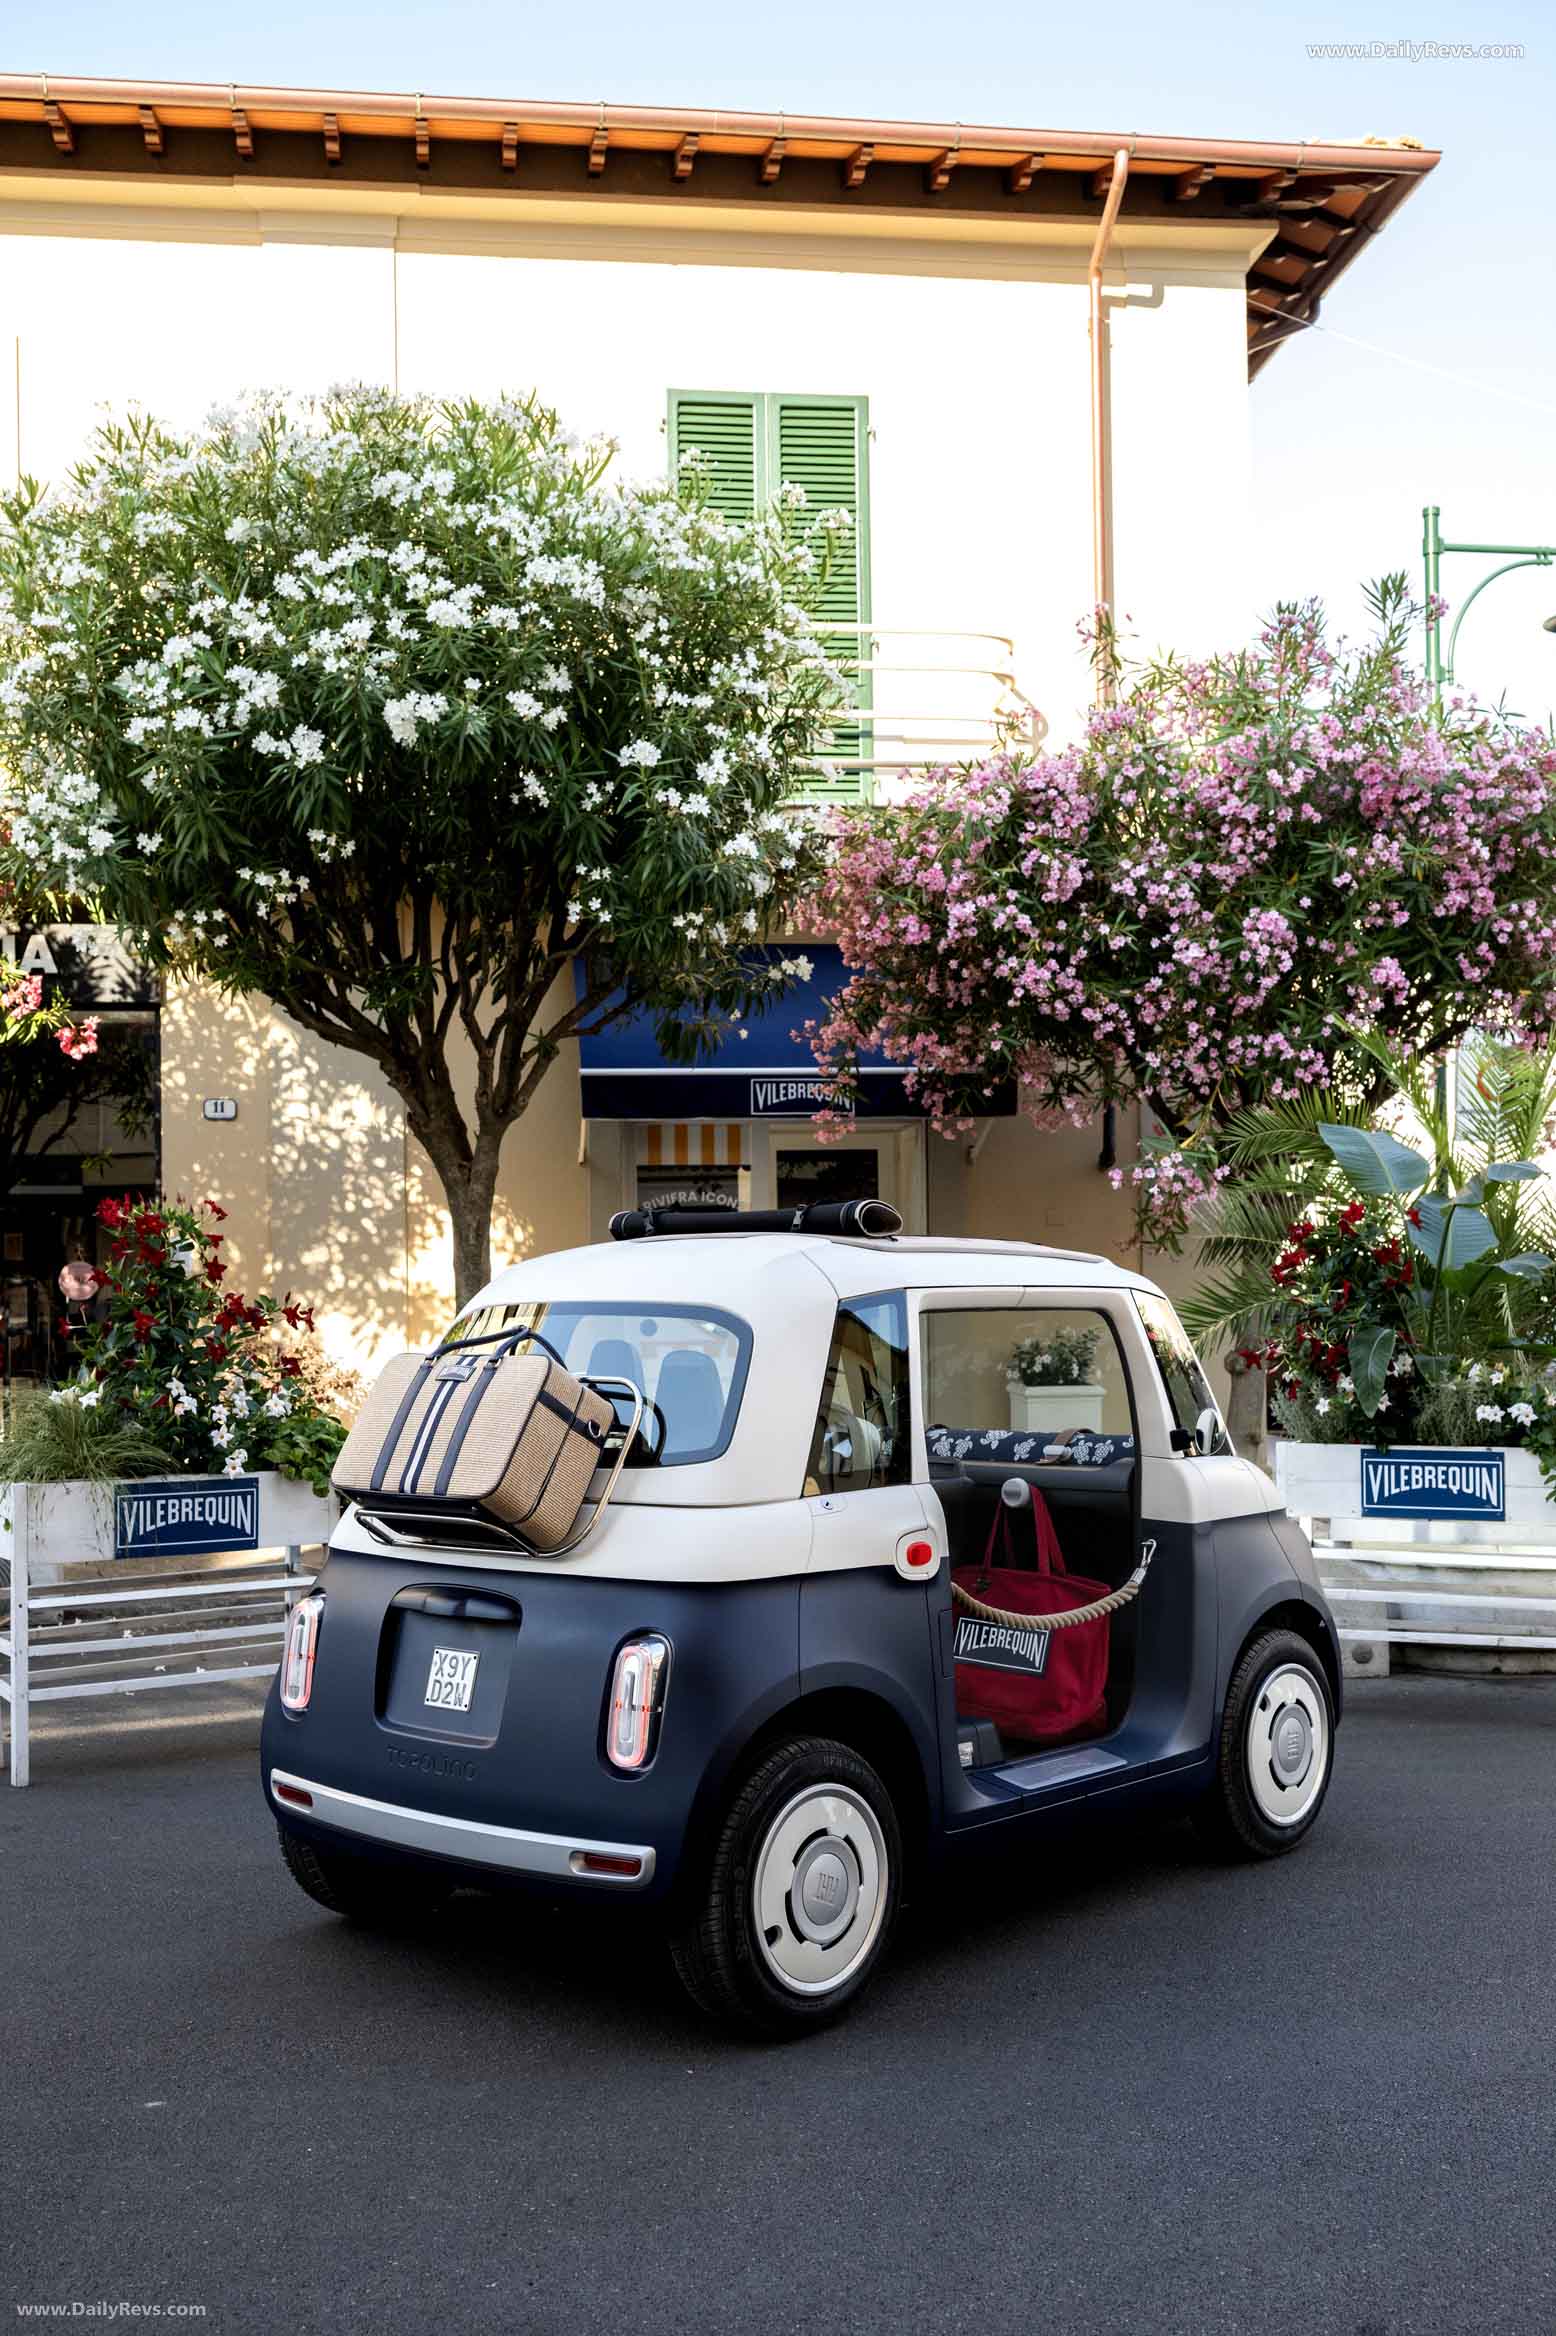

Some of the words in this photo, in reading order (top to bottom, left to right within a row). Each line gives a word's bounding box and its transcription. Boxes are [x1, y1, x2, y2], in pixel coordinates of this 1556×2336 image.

[213, 1101, 225, 1113] 11
[1367, 1464, 1498, 1507] VILEBREQUIN
[122, 1494, 252, 1544] VILEBREQUIN
[434, 1653, 472, 1681] X9Y
[959, 1622, 1045, 1669] VILEBREQUIN
